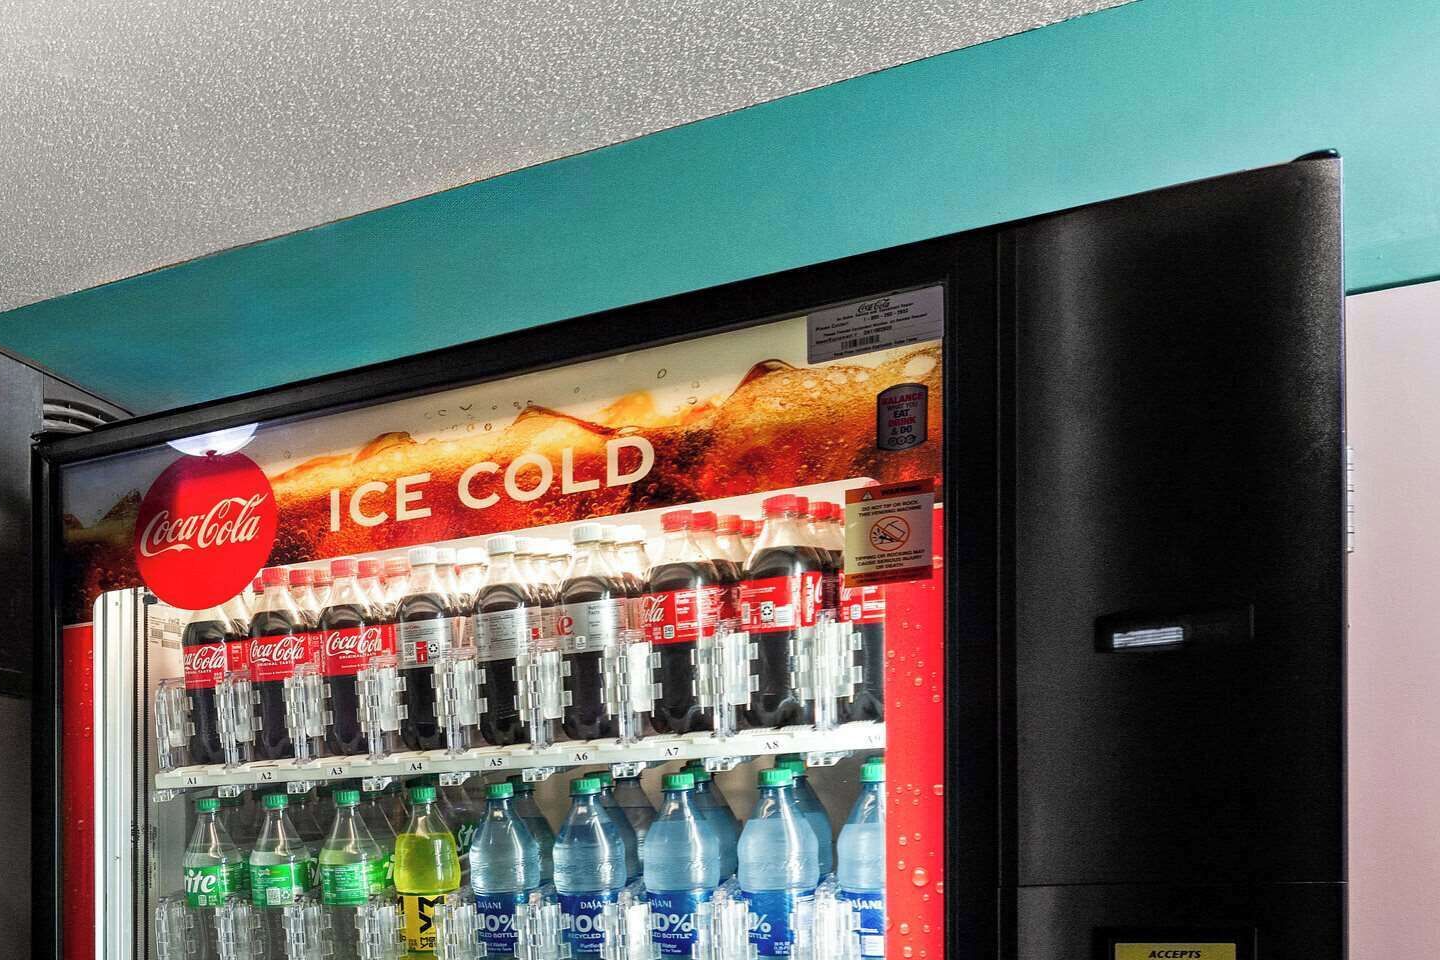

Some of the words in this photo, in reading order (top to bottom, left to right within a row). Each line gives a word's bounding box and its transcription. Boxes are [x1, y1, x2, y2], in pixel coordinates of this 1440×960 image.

[894, 409, 910, 418] EAT
[330, 472, 432, 532] ICE
[457, 436, 655, 510] COLD
[140, 492, 267, 557] Coca-Cola
[250, 636, 306, 663] Coca-Cola
[764, 741, 779, 750] A8
[574, 751, 588, 761] A6
[664, 747, 679, 757] A7
[410, 762, 422, 771] A4
[489, 757, 503, 767] A5
[331, 767, 343, 776] A3
[187, 777, 197, 785] A1
[260, 772, 272, 781] A2
[184, 869, 216, 893] rite
[1148, 950, 1202, 959] ACCEPTS
